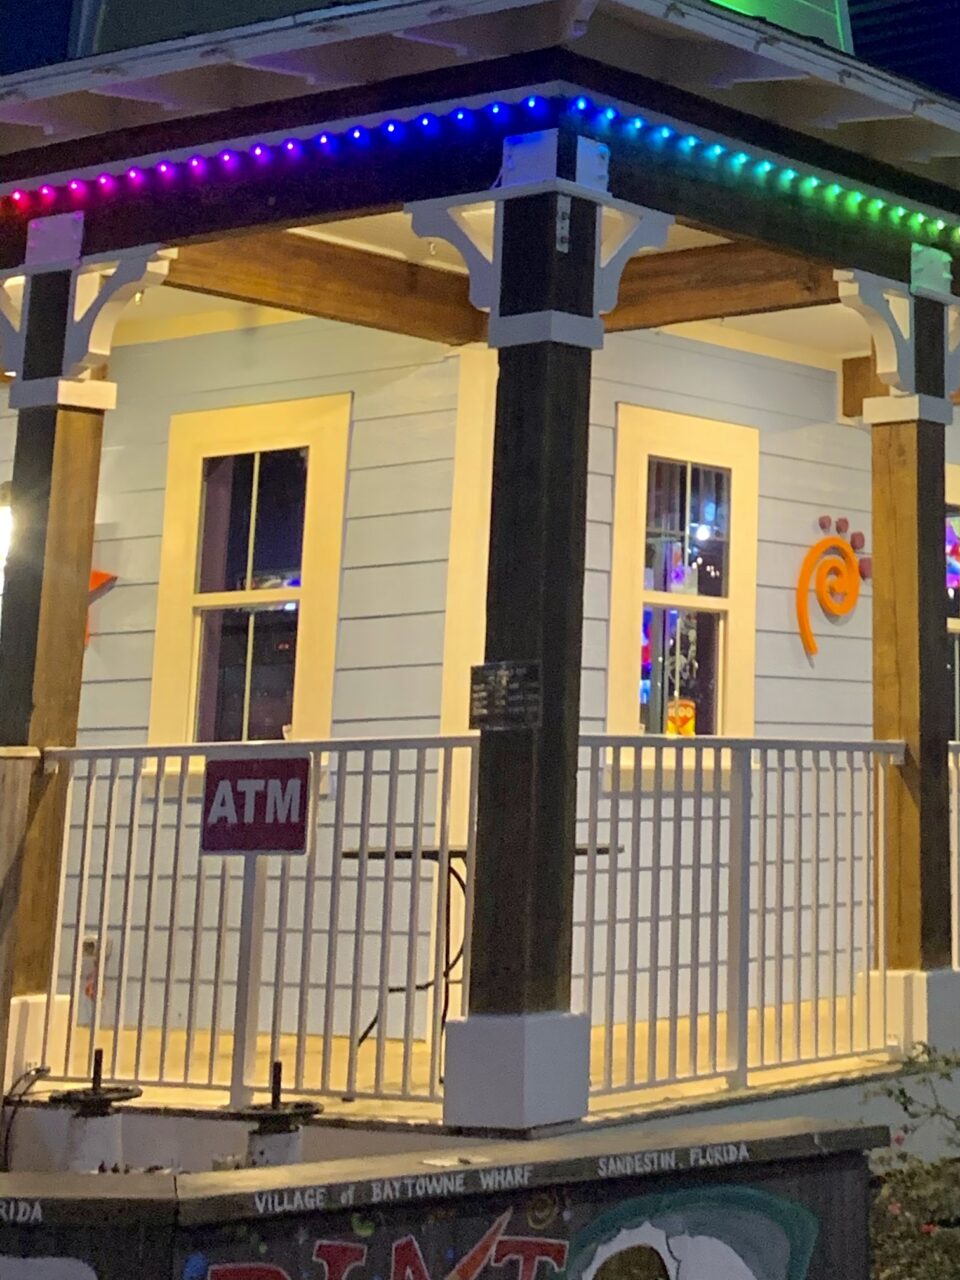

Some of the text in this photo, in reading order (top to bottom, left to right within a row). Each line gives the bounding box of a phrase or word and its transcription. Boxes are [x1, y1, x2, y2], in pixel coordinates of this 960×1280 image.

[207, 778, 301, 824] ATM
[254, 1188, 327, 1213] VILLAGE
[340, 1186, 355, 1205] of
[371, 1173, 465, 1201] BAYTOWNE
[479, 1165, 534, 1190] WHARF
[689, 1143, 750, 1166] FLORIDA
